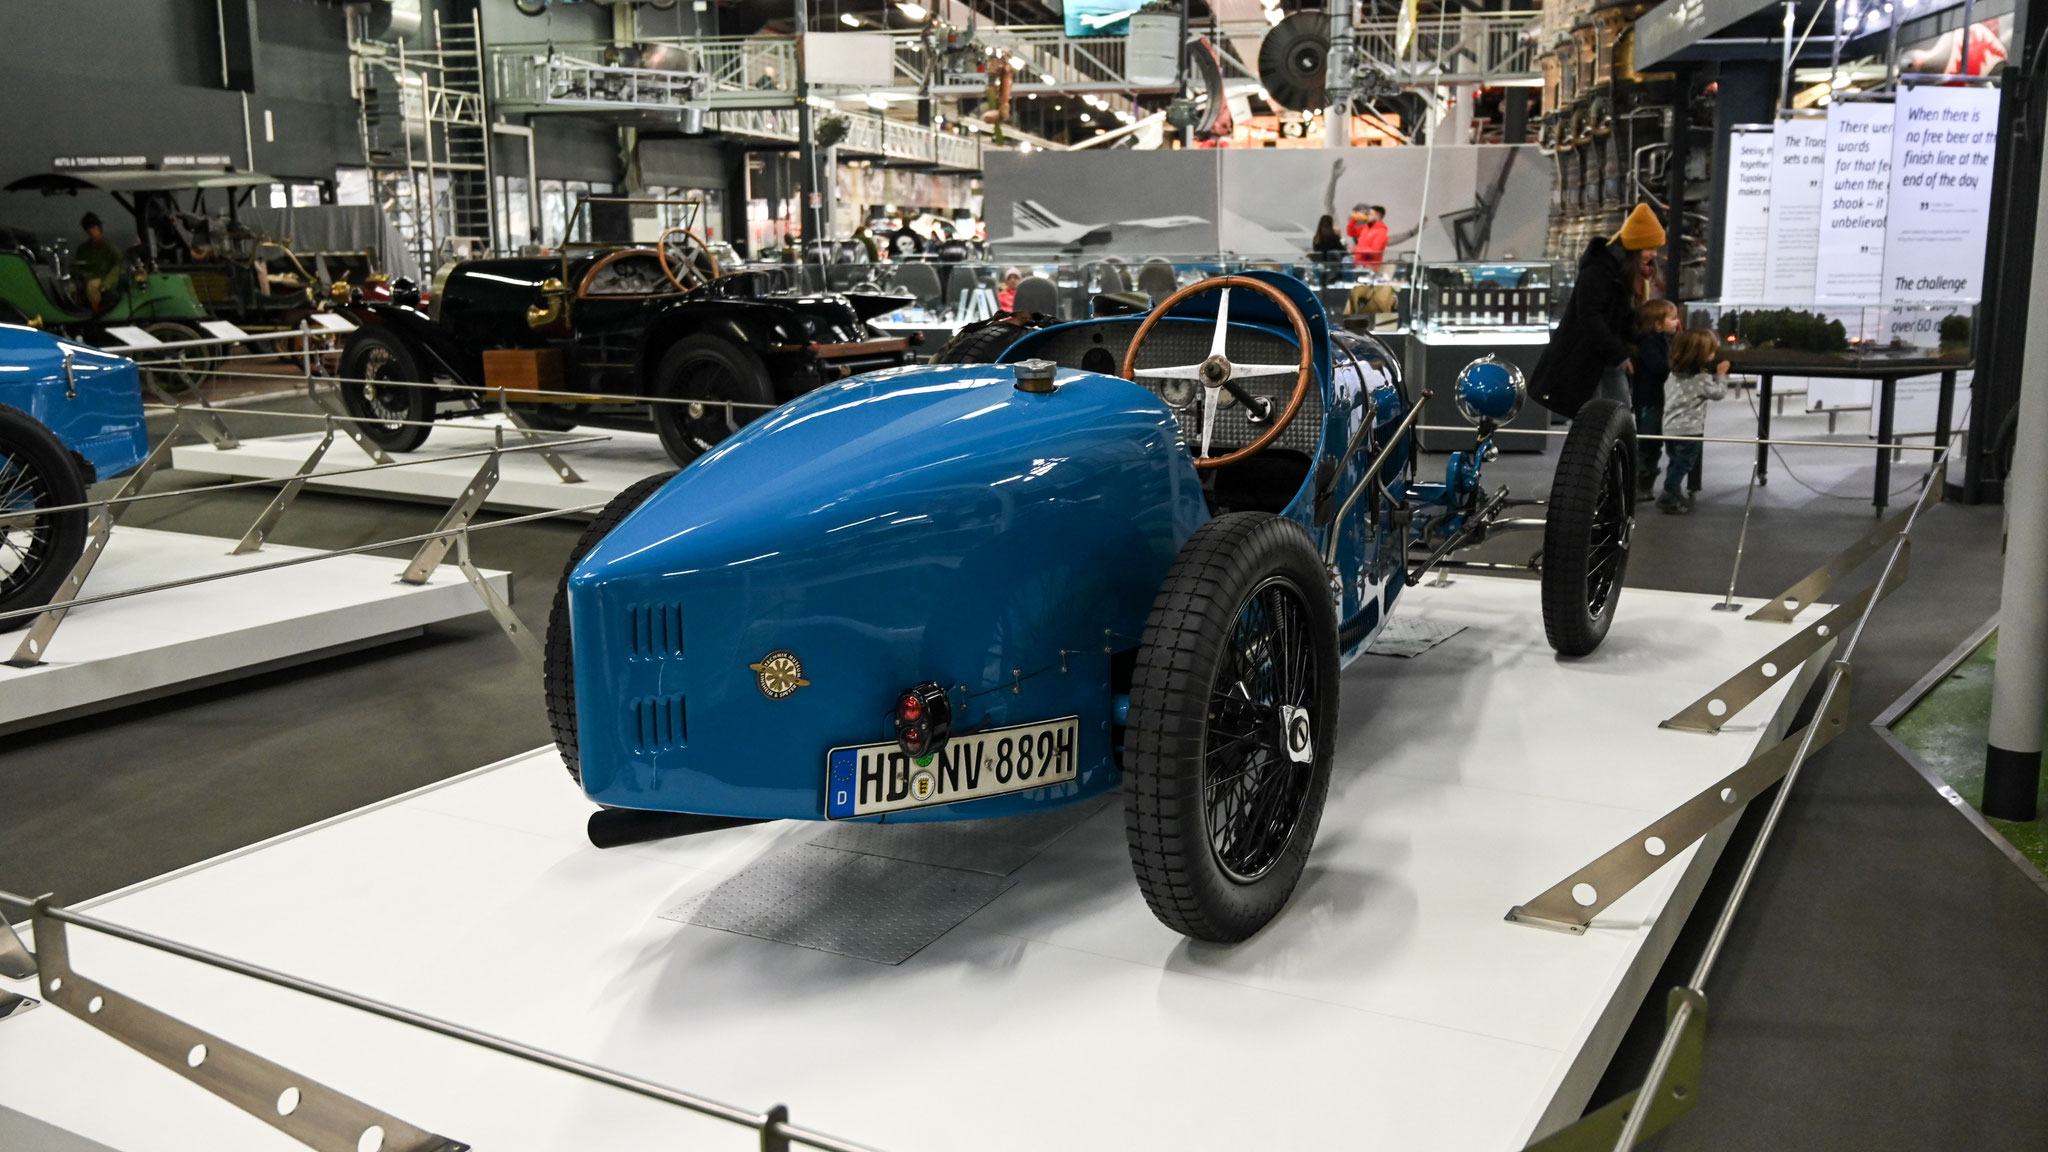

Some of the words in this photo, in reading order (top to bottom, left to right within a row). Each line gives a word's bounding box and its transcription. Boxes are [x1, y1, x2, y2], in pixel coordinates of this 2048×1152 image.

[1908, 107, 1939, 121] When
[1942, 107, 1969, 121] there
[1971, 107, 1981, 122] is
[1839, 120, 1869, 133] There
[1785, 136, 1801, 147] The
[1905, 131, 1920, 143] no
[1922, 128, 1944, 146] free
[1946, 128, 1970, 144] beer
[1972, 131, 1983, 144] at
[1740, 146, 1765, 157] Seeing
[1837, 140, 1870, 152] words
[1740, 159, 1769, 171] together
[1783, 155, 1801, 165] sets
[1903, 149, 1935, 168] finish
[1937, 150, 1957, 165] line
[1958, 152, 1970, 165] at
[1971, 151, 1989, 166] the
[1835, 158, 1852, 174] for
[1854, 159, 1875, 171] that
[1739, 173, 1767, 184] Tupolev
[1834, 178, 1864, 190] when
[1867, 178, 1884, 191] the
[1902, 172, 1924, 186] end
[1925, 171, 1938, 190] of
[1939, 172, 1957, 186] the
[1958, 172, 1979, 190] day
[1738, 187, 1761, 196] makes
[1832, 197, 1864, 210] shook
[1875, 197, 1884, 210] it
[1895, 276, 1914, 290] The
[1916, 275, 1968, 293] challenge
[1891, 320, 1915, 333] over
[1916, 319, 1932, 333] 60
[764, 652, 788, 667] TECHNIK
[788, 654, 803, 678] MUSEUM
[860, 750, 910, 805] HD
[937, 741, 985, 794] NV
[995, 726, 1075, 785] 889H
[836, 790, 848, 806] D
